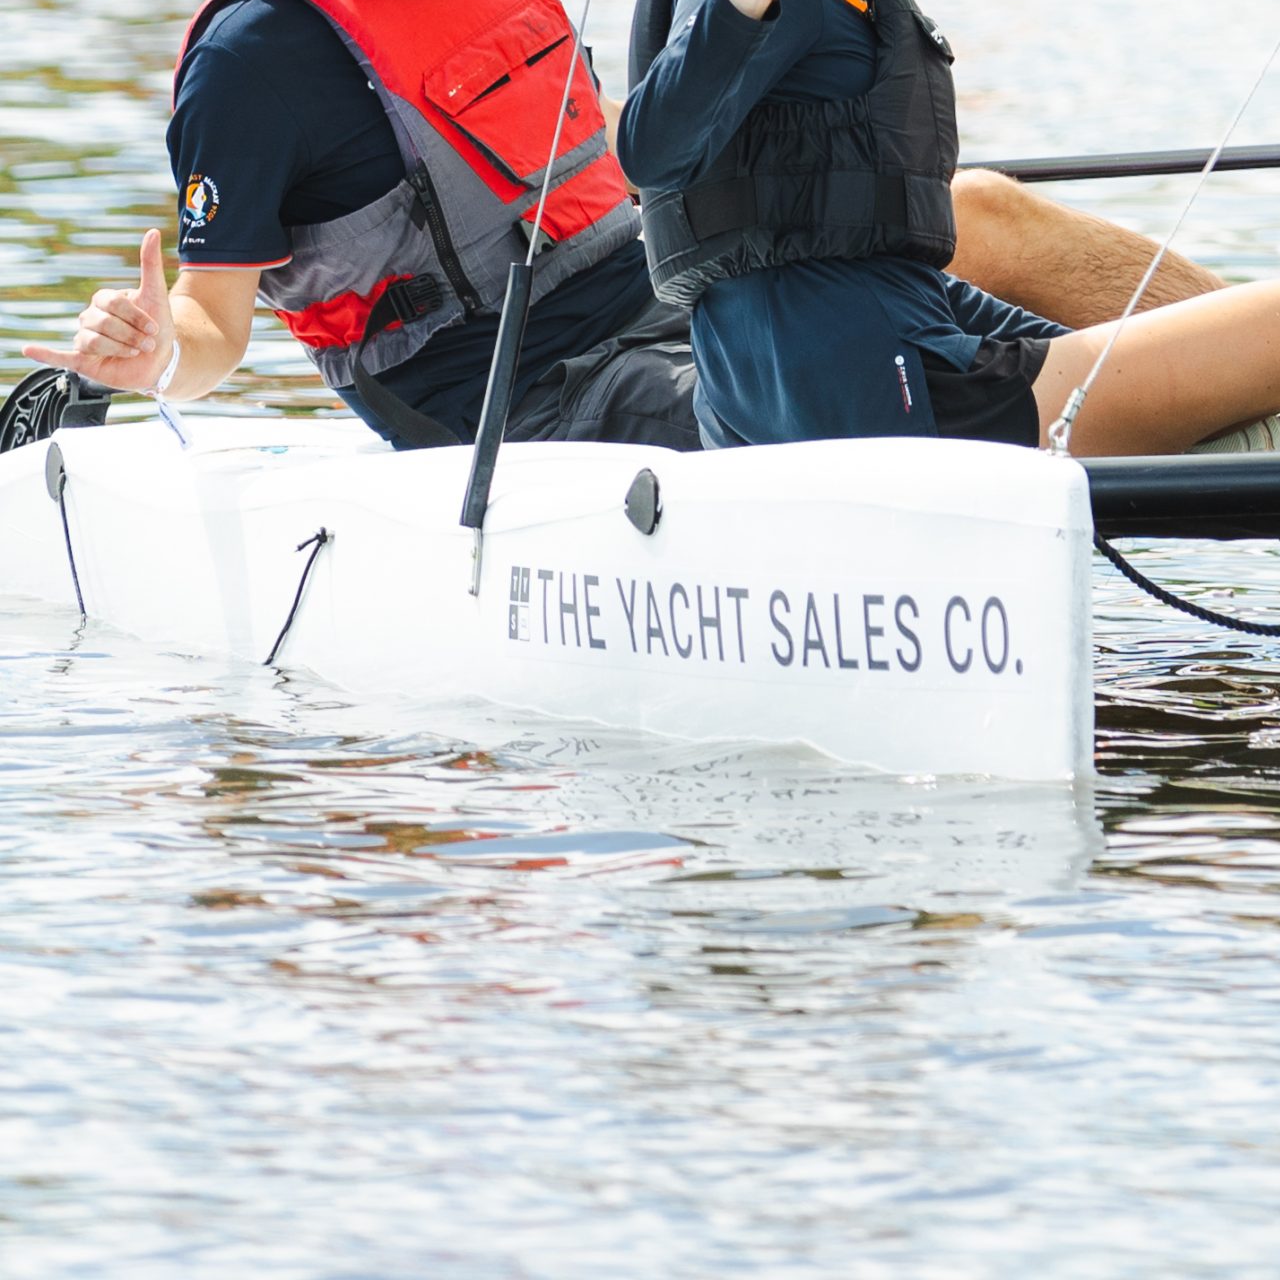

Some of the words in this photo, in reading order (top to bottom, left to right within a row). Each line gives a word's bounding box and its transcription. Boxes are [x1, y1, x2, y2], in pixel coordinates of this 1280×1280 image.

[537, 569, 607, 651] THE
[615, 577, 749, 664] YACHT
[768, 589, 923, 674] SALES
[943, 594, 1024, 676] CO.
